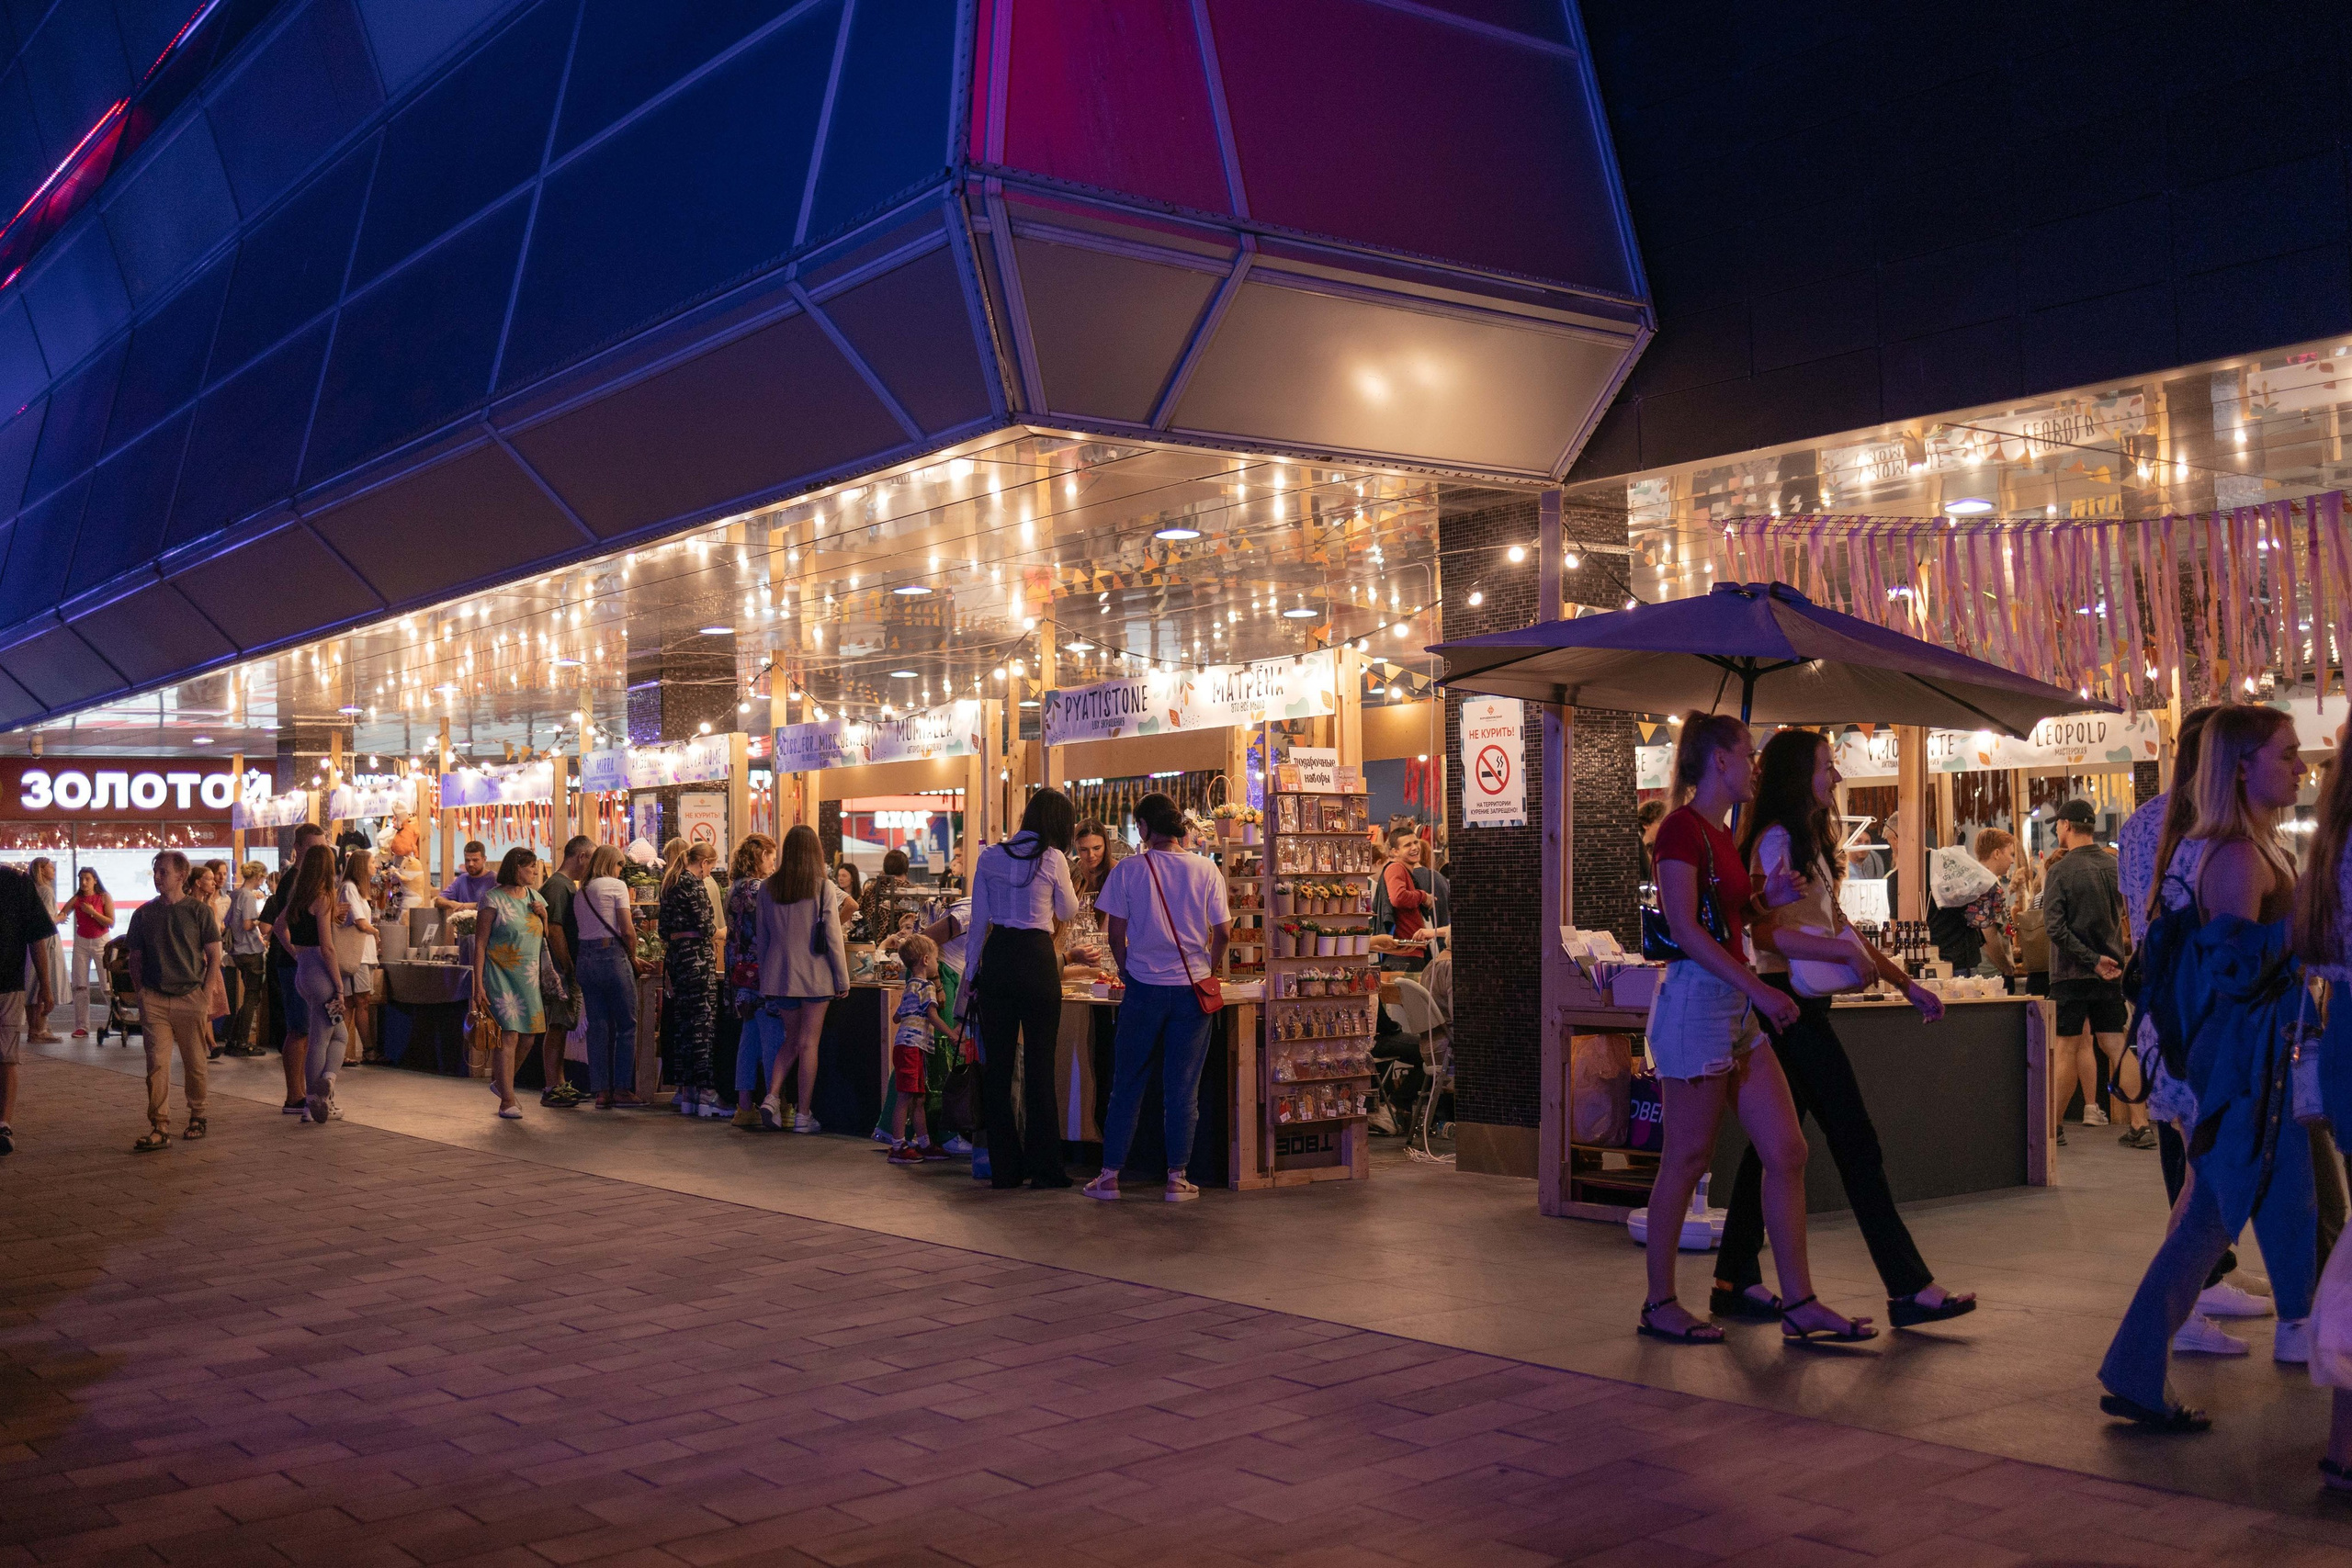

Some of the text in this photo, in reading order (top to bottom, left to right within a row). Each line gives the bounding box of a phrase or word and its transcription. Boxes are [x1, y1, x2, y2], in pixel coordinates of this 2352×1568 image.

[1213, 664, 1283, 704] МАТРЁНА
[1065, 684, 1148, 722] PYATISTONE
[1468, 726, 1515, 739] НЕ КУРИТЬ!
[2035, 721, 2107, 747] LEOPOLD
[2054, 746, 2087, 756] МАСТЕРСКАЯ
[596, 757, 615, 773] MIRRA
[1294, 756, 1336, 770] подарочные
[1305, 772, 1330, 786] наборы
